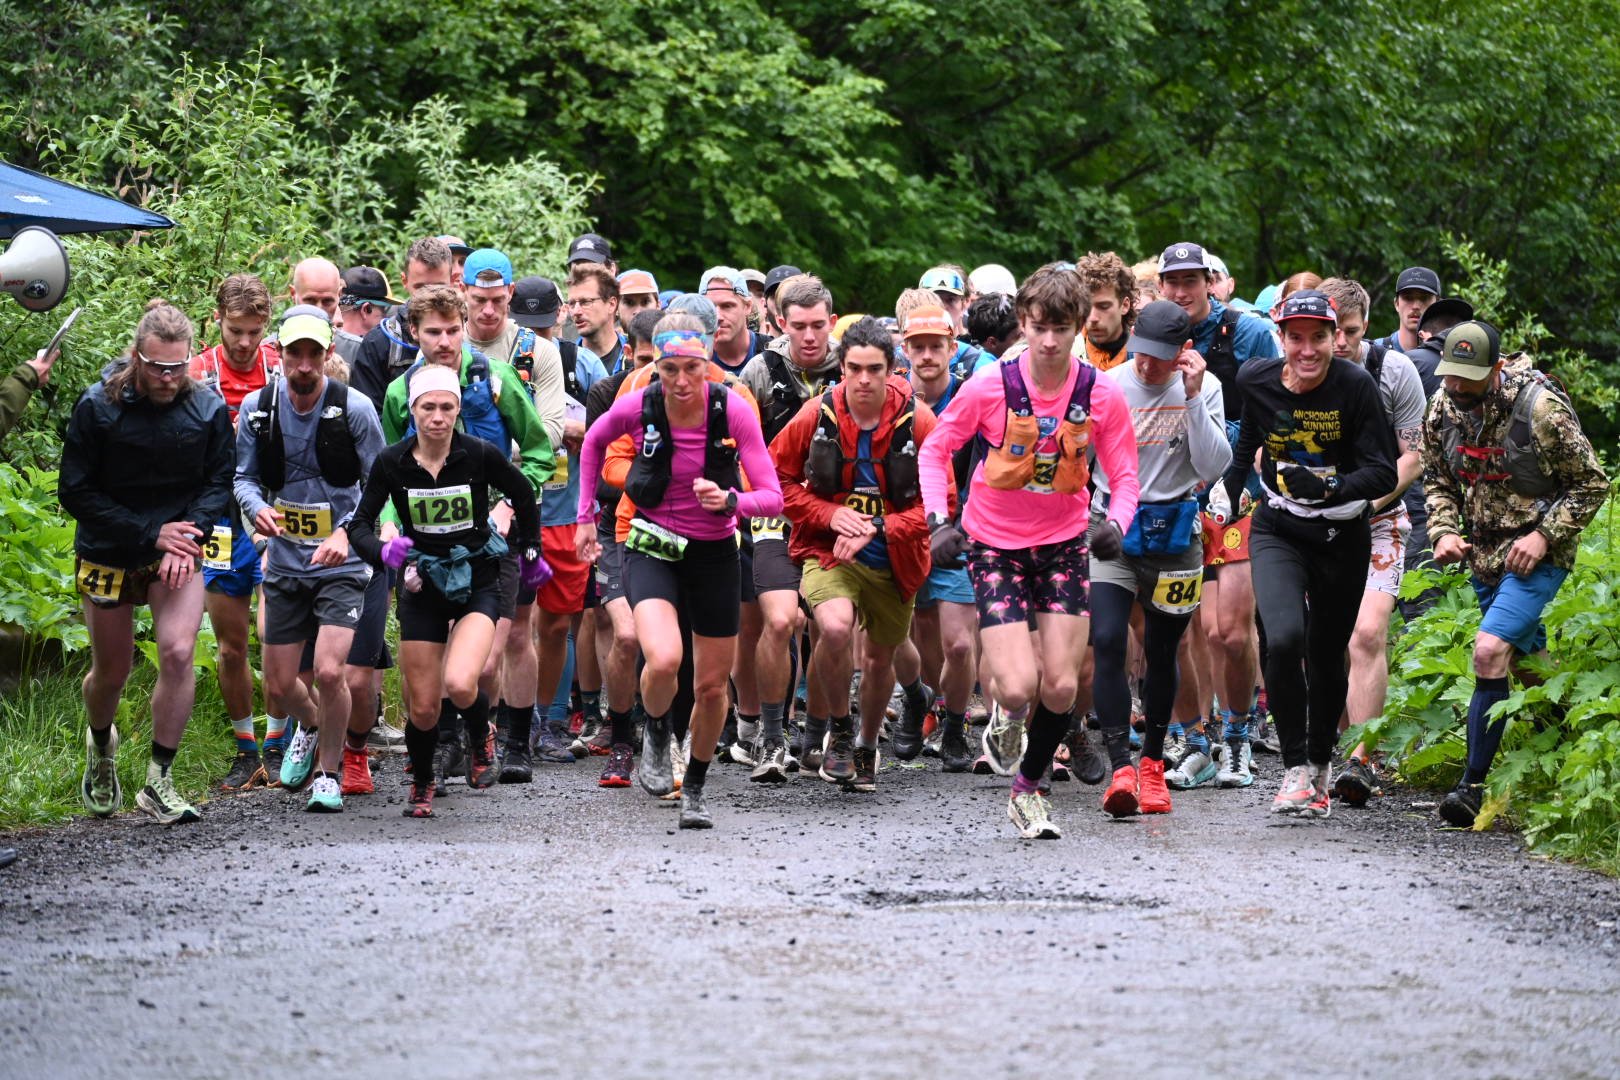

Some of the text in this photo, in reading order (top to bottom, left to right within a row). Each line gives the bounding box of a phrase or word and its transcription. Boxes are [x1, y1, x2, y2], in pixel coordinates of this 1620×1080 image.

[1293, 410, 1340, 421] ANCHORAGE
[1303, 421, 1341, 431] RUNNING
[413, 497, 470, 523] 128
[285, 510, 318, 536] 55
[83, 569, 115, 595] 41
[1166, 580, 1197, 604] 84
